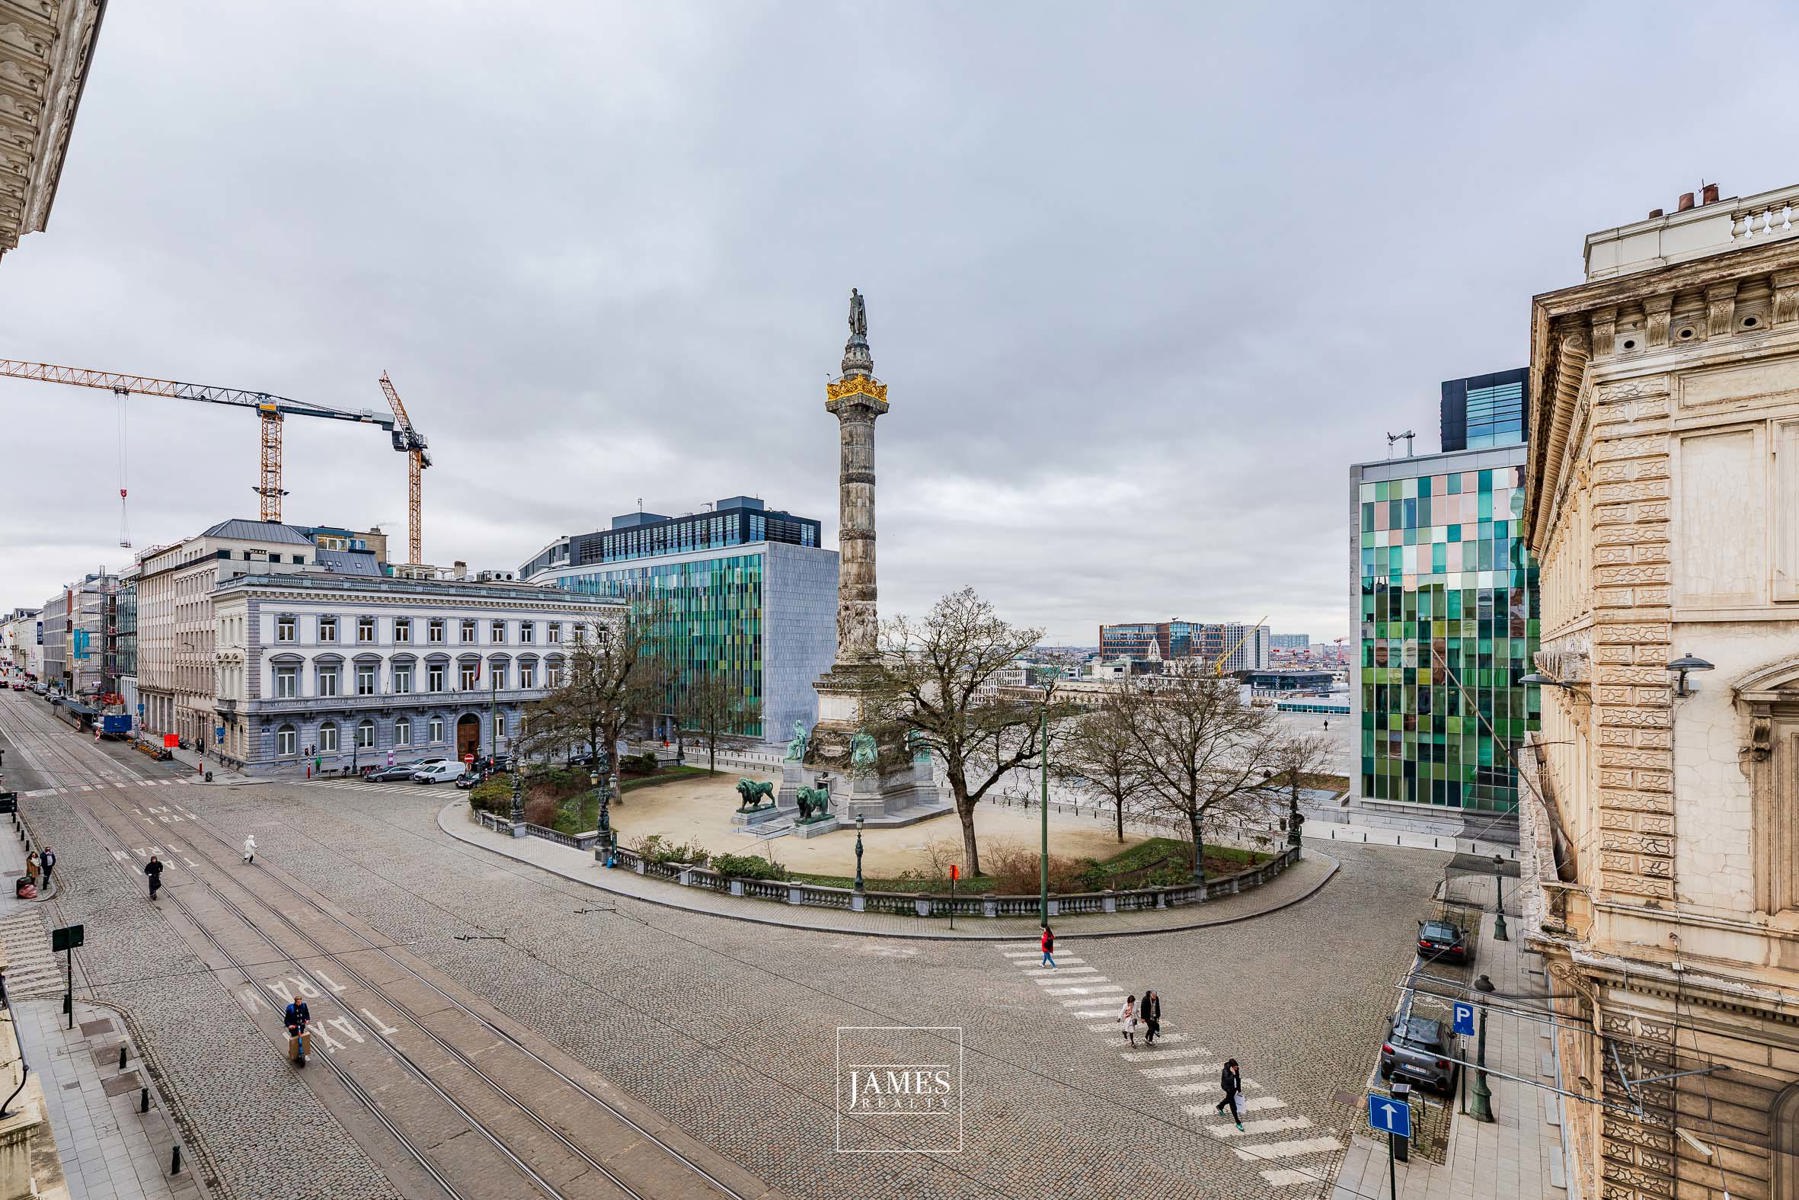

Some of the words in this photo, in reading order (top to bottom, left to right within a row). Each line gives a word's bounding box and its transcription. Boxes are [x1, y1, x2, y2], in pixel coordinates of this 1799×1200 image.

[111, 844, 184, 861] TRAM
[130, 857, 200, 876] TAI
[236, 970, 347, 1015] TRAM
[1456, 1006, 1471, 1023] P
